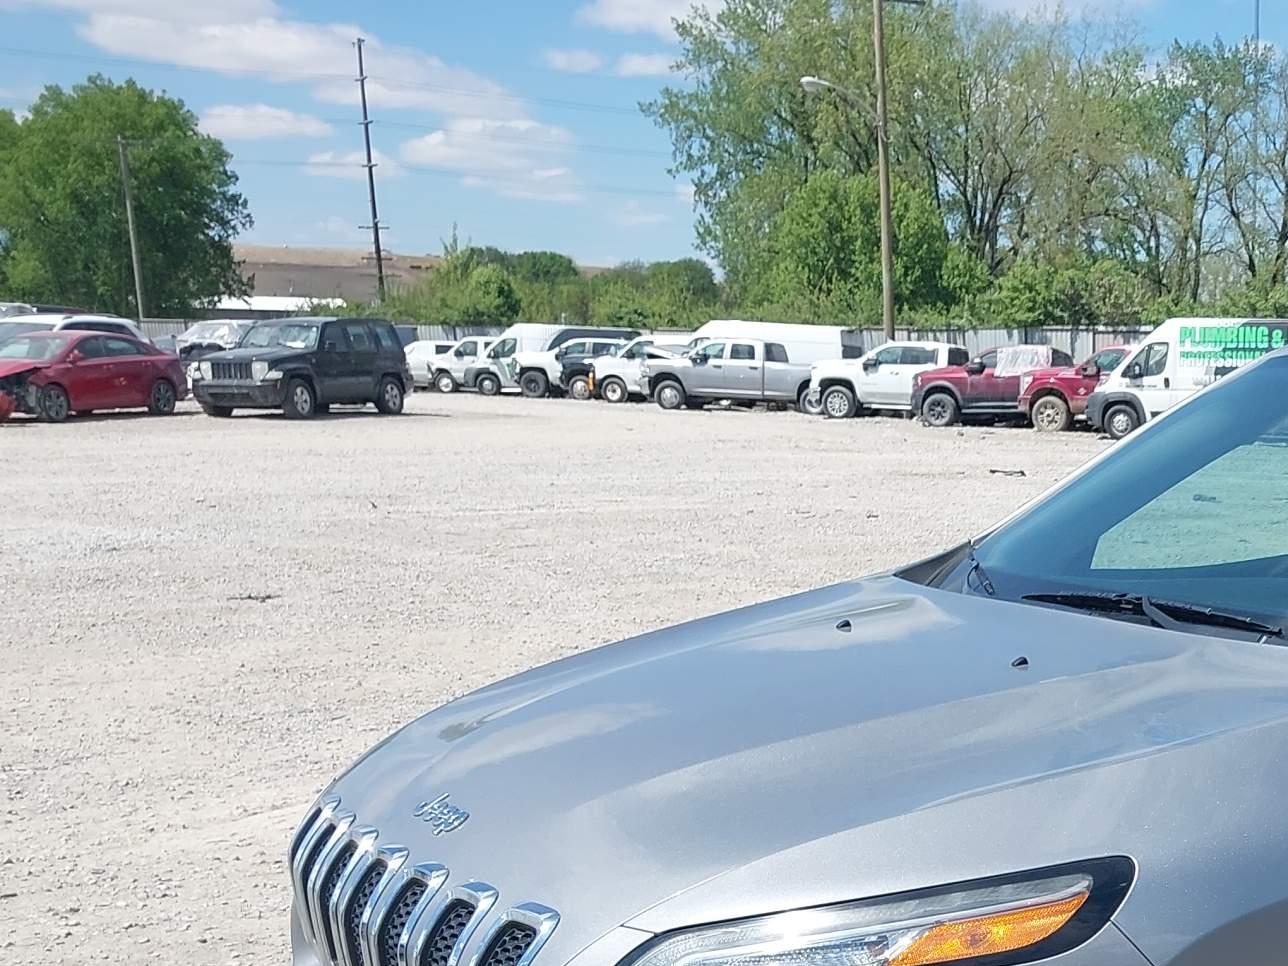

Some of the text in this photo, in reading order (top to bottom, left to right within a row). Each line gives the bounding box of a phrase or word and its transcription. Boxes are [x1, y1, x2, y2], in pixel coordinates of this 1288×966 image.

[1179, 326, 1269, 349] PLUMBING
[1270, 329, 1285, 348] &
[413, 792, 470, 836] Jeep
